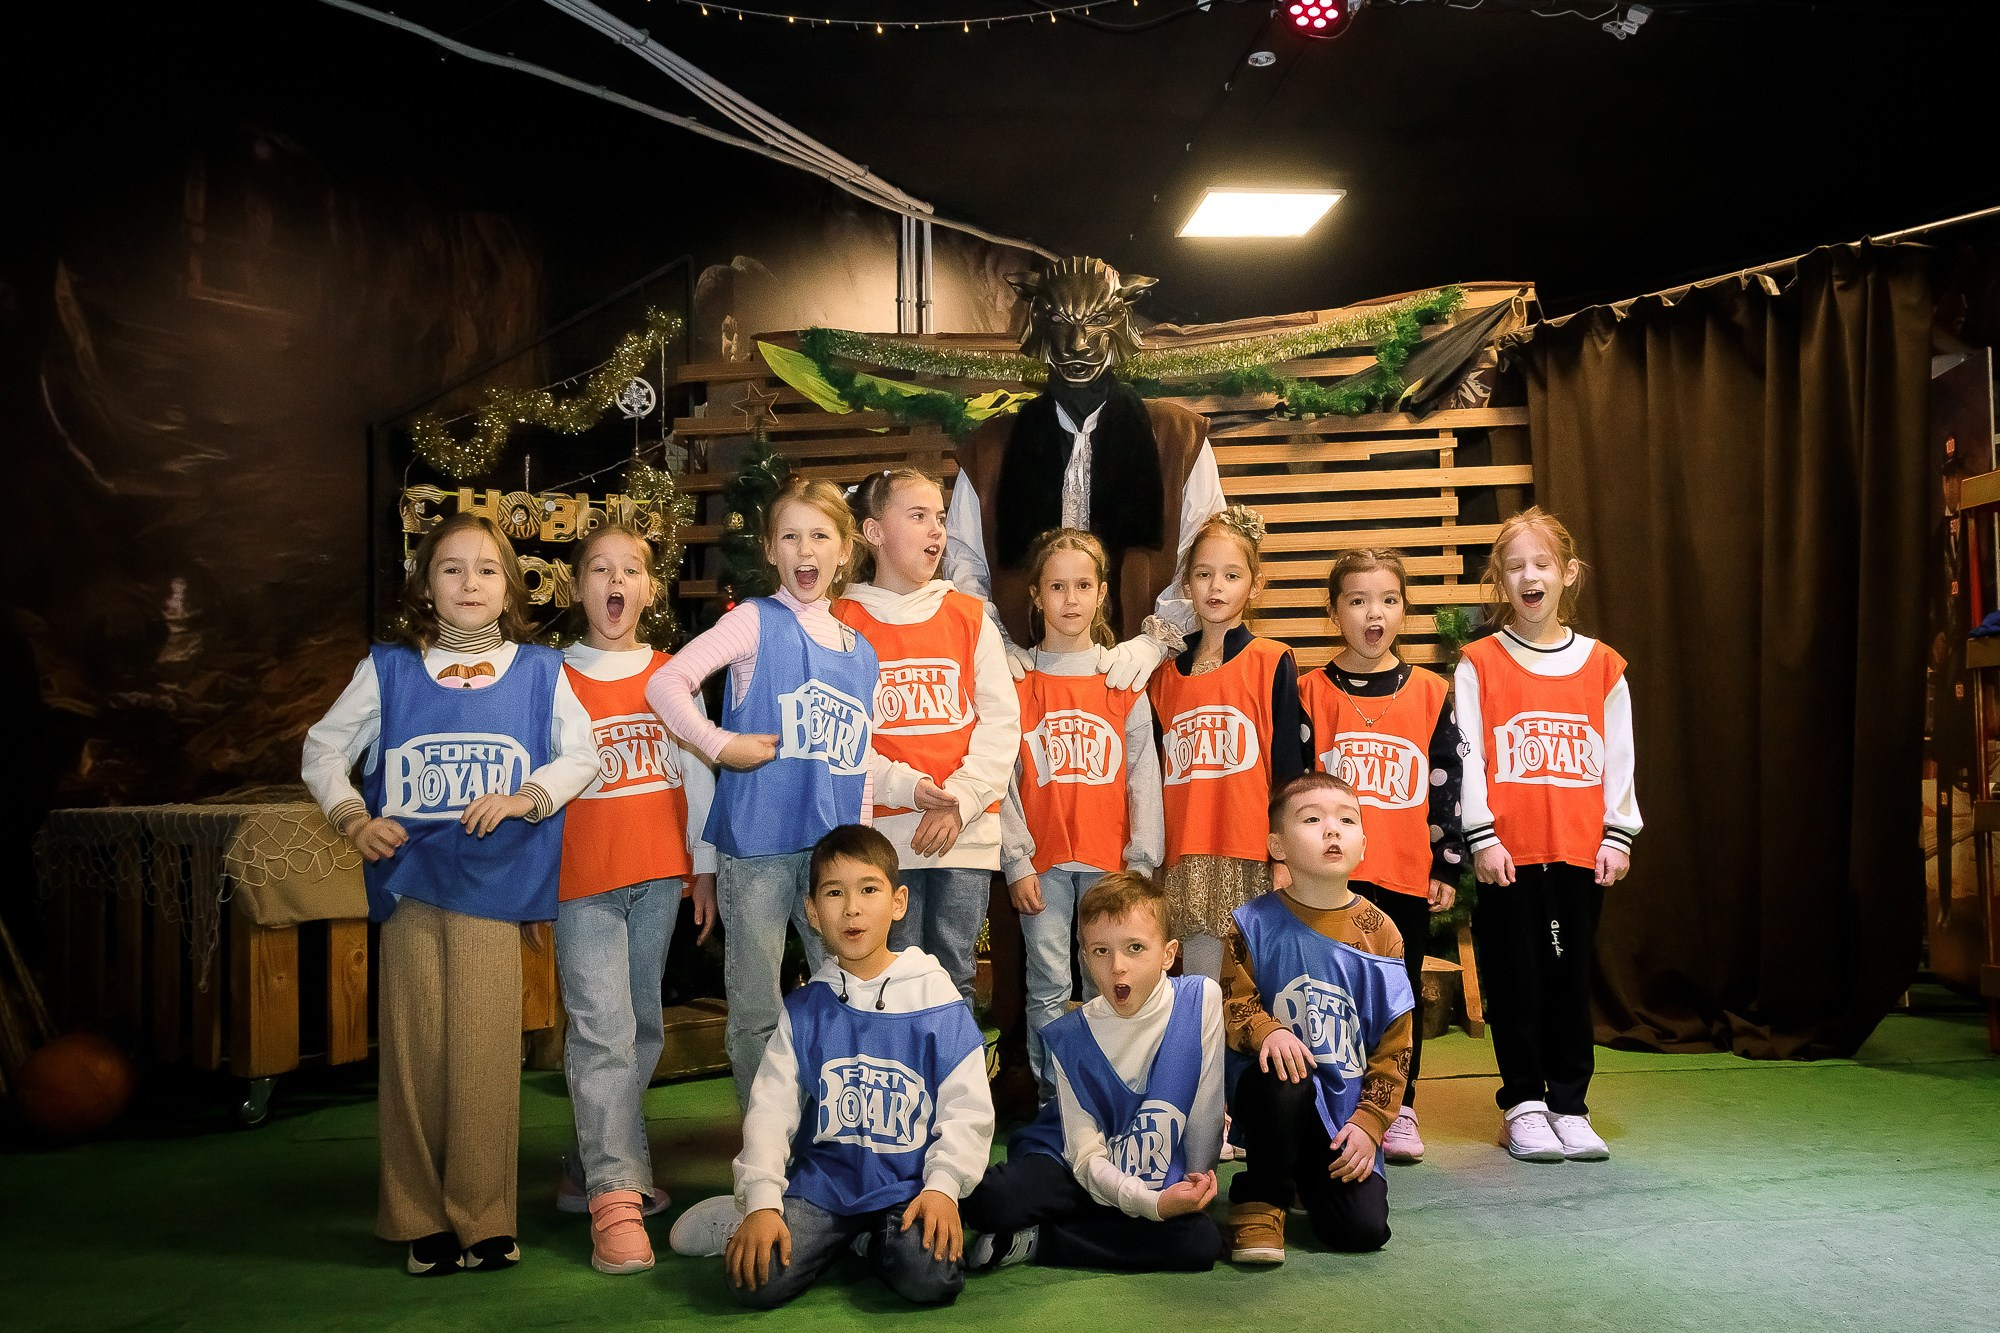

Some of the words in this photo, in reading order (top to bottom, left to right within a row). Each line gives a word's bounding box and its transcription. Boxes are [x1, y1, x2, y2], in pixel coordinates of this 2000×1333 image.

[880, 668, 942, 685] FORT
[809, 689, 852, 720] FORT
[593, 723, 657, 745] FORT
[1047, 718, 1095, 735] FORT
[1177, 714, 1225, 737] FORT
[1523, 719, 1583, 737] FORT
[424, 743, 499, 762] FORT
[1339, 741, 1397, 758] FORT
[1493, 724, 1605, 788] BOYARD
